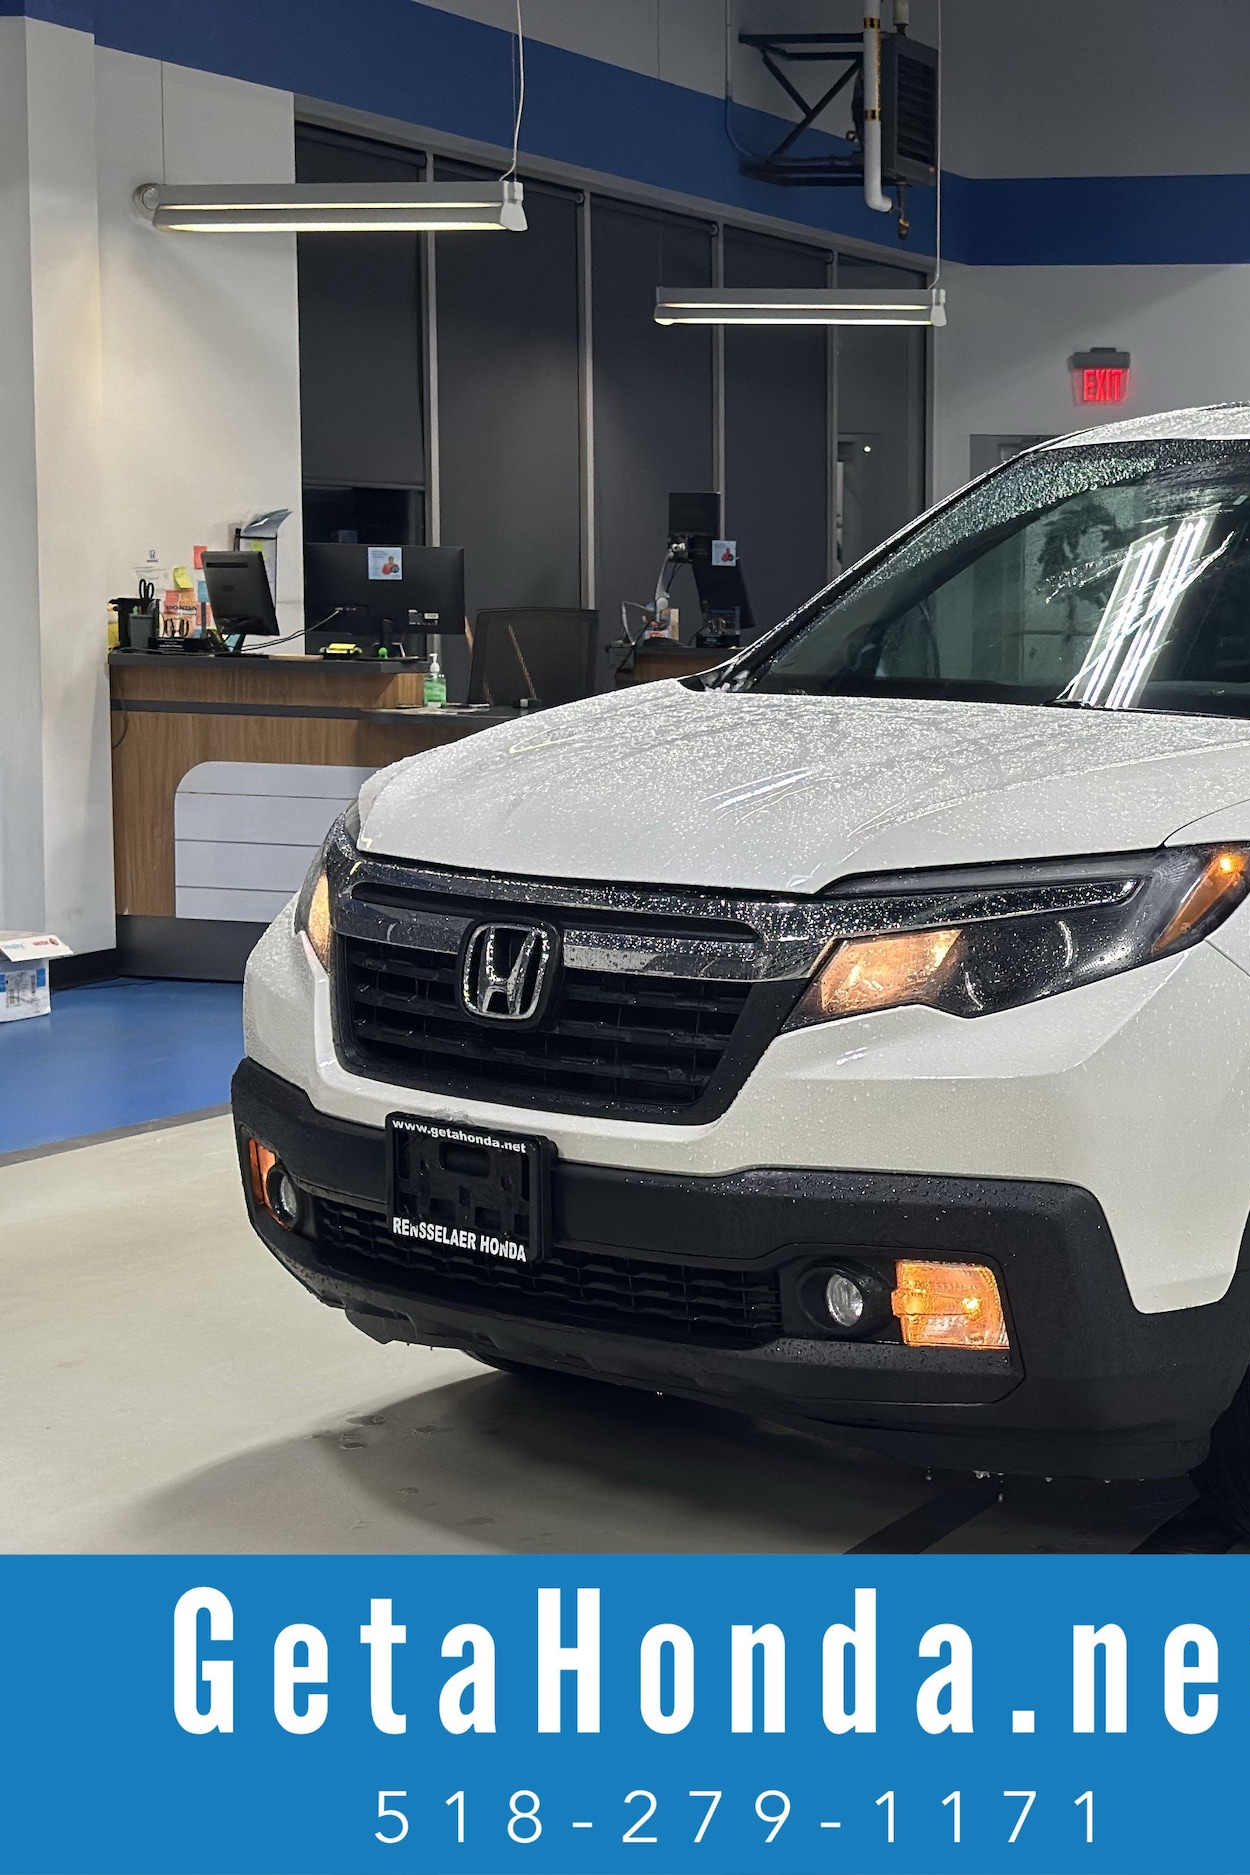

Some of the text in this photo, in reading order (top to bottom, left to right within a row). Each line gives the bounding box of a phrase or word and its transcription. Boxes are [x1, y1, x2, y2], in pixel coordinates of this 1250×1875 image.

[1084, 369, 1122, 401] EXIT
[392, 1119, 527, 1153] www.getahonda.net
[393, 1217, 526, 1262] RENSSELAER HONDA
